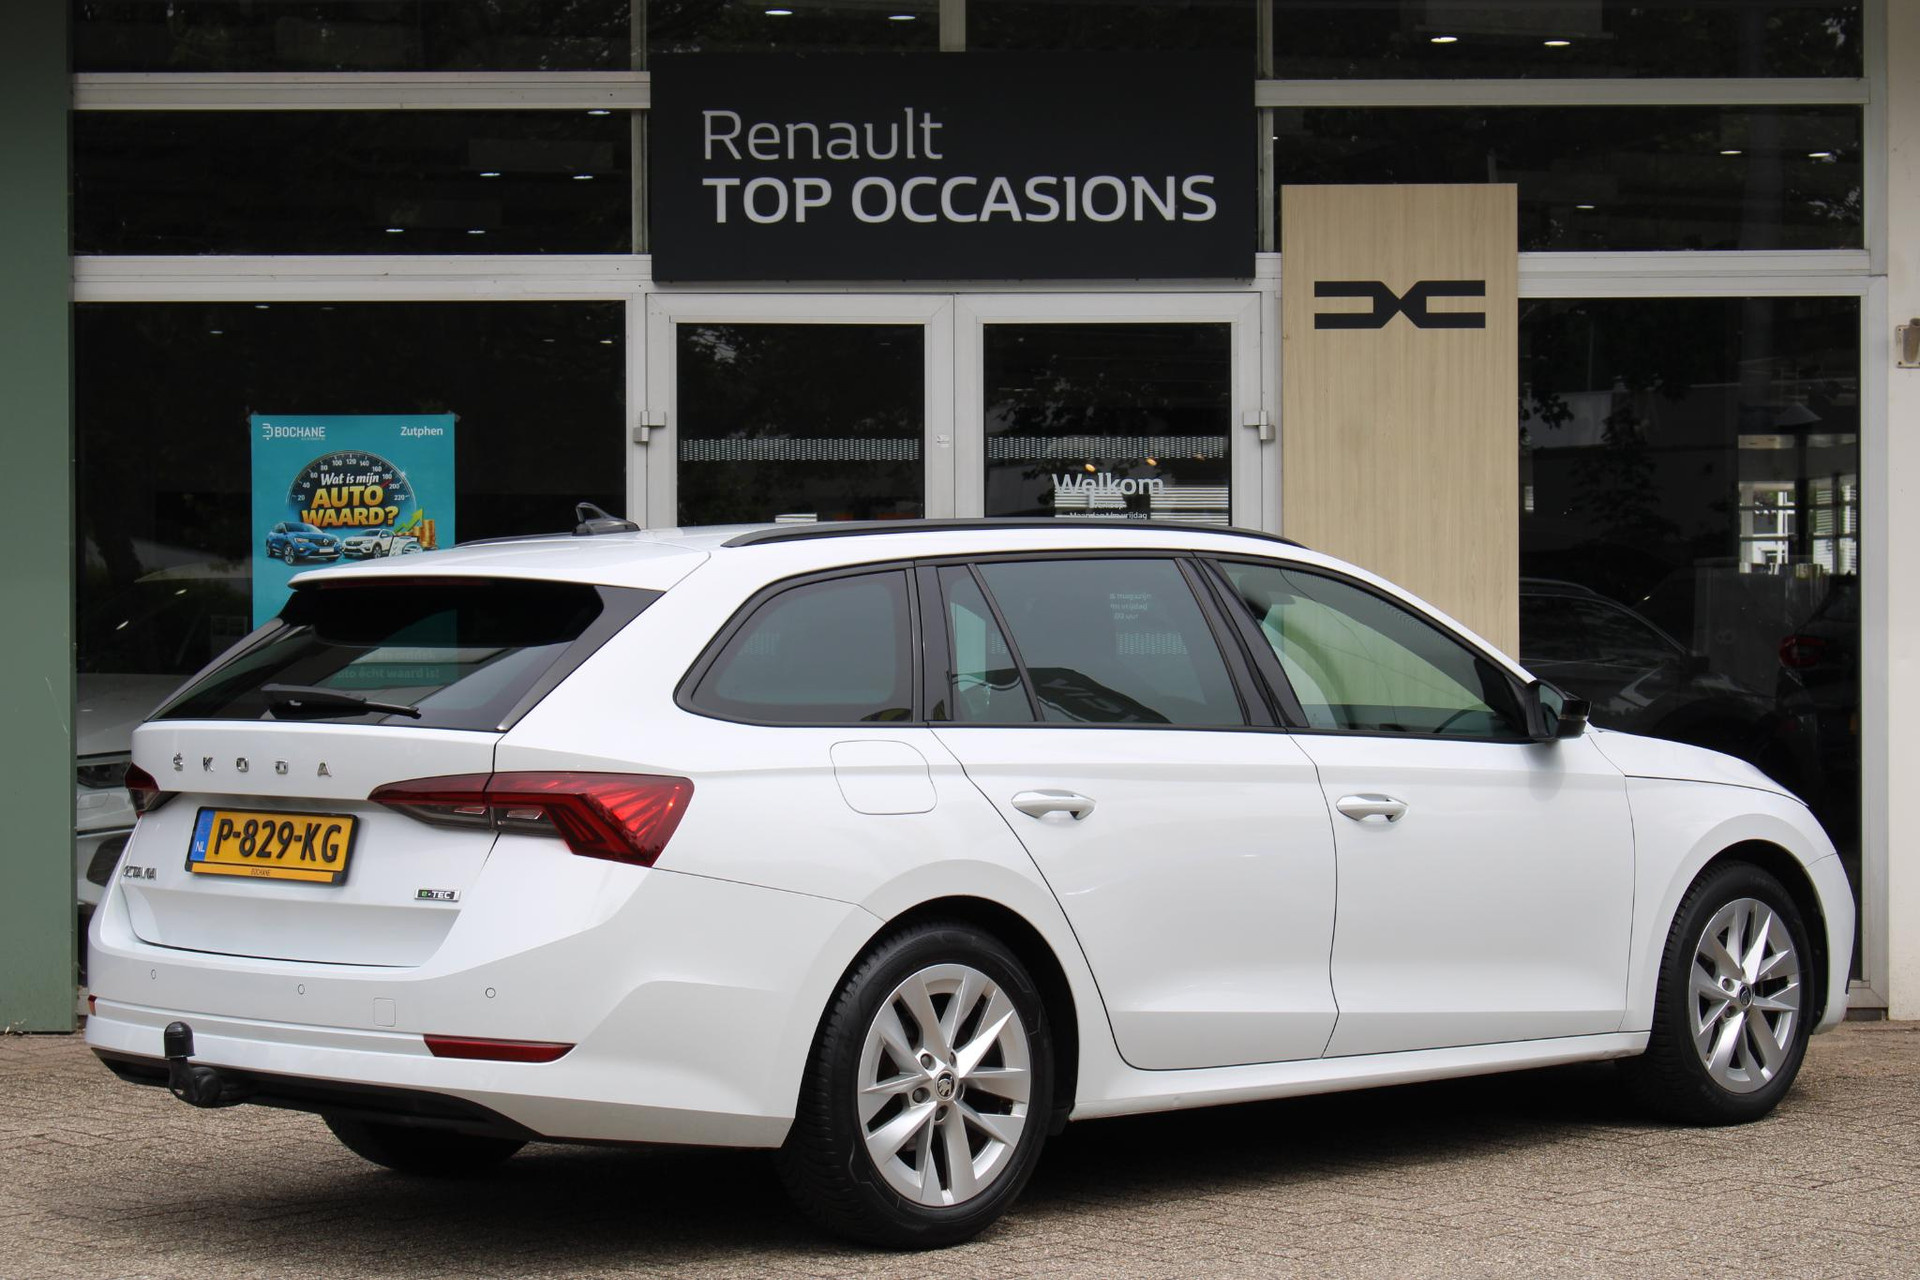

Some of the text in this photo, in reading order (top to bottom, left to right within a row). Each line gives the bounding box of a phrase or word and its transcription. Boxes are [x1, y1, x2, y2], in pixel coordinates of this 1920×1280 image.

[702, 107, 943, 160] Renault
[702, 175, 1217, 224] TOP OCCASIONS
[274, 426, 326, 438] BOCHANE
[401, 426, 443, 438] Zutphen
[320, 472, 379, 486] Wat is mijn
[1052, 472, 1166, 495] Welkom
[311, 485, 384, 509] AUTO
[302, 506, 399, 527] WAARD?
[195, 841, 205, 852] NL
[214, 818, 342, 863] P-829-KG
